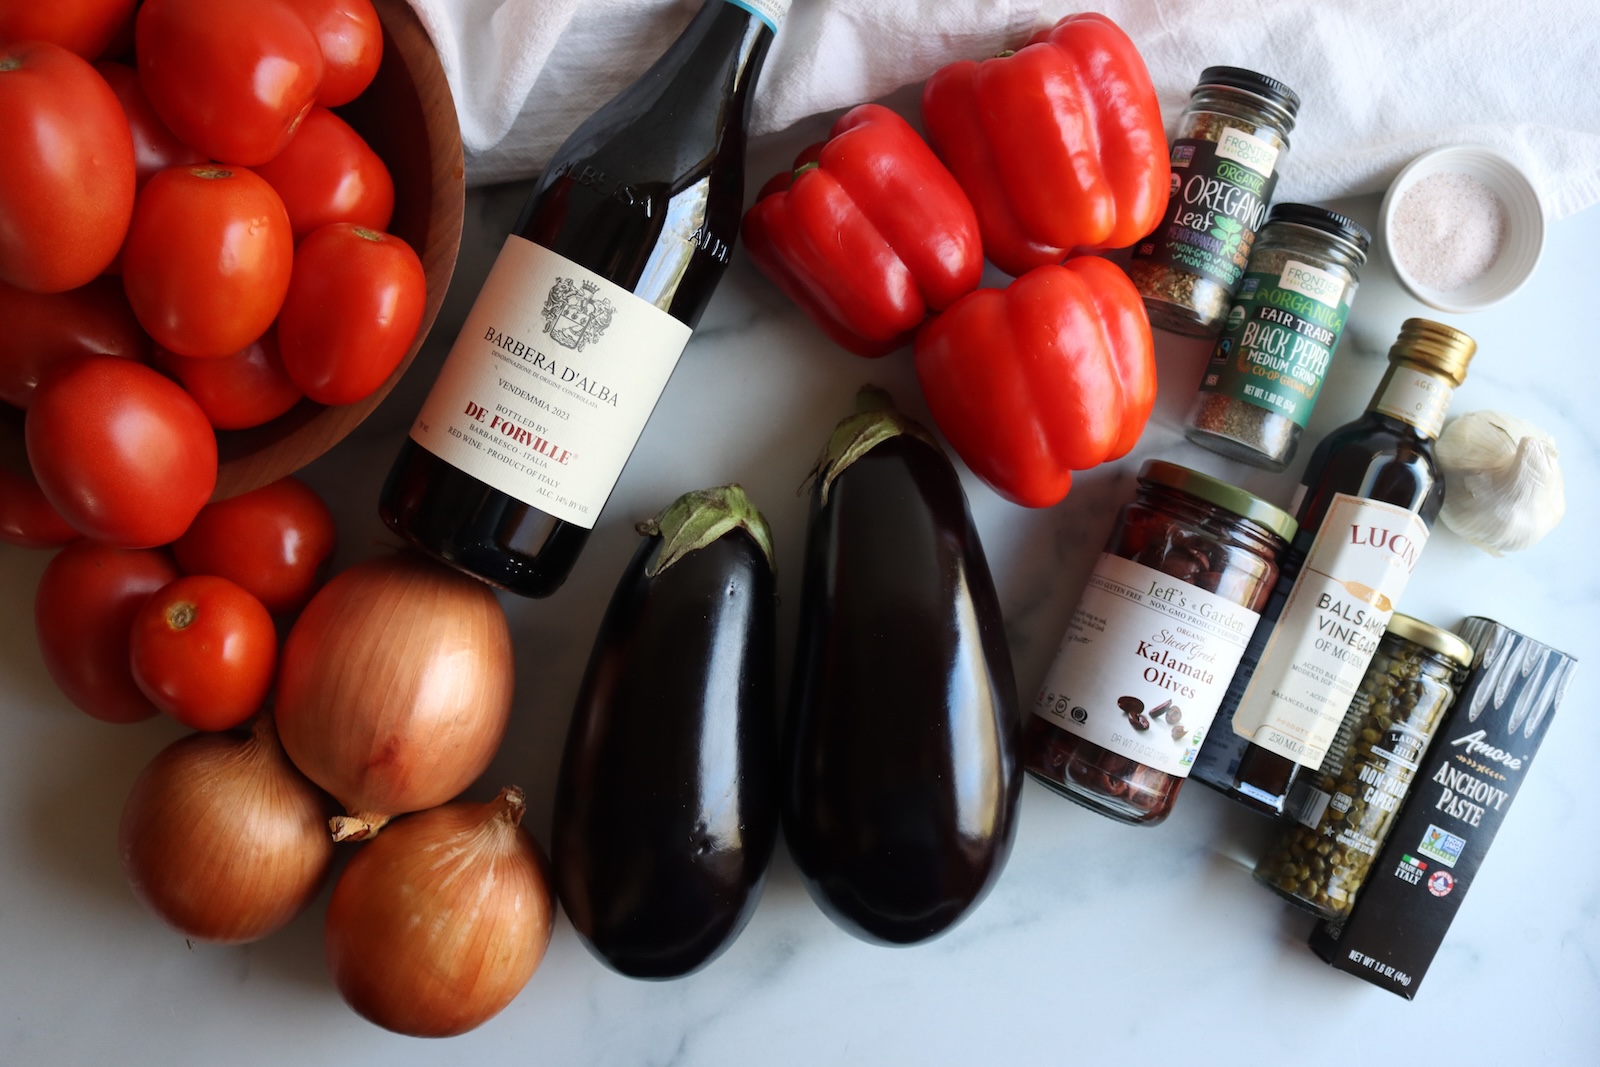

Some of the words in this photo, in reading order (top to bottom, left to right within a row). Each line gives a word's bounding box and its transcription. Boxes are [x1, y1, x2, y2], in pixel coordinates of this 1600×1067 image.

[1224, 135, 1274, 162] FRONTIER
[1216, 163, 1265, 193] ORGANIC
[1173, 203, 1214, 232] Leaf
[1184, 174, 1266, 233] OREGANO
[1167, 225, 1223, 255] MEDITERRANEAN
[1174, 242, 1212, 261] NON-GMO
[1181, 254, 1235, 285] NON-IRRADIATED
[1287, 267, 1340, 295] FRONTIER
[1300, 281, 1326, 296] CO-OP
[1268, 289, 1334, 327] ORGANIC
[1260, 306, 1294, 328] FAIR
[1295, 318, 1335, 346] TRADE
[1240, 321, 1292, 358] BLACK
[1288, 335, 1330, 379] PEPPER
[484, 326, 556, 375] BARBERA
[560, 366, 619, 407] D'ALBA
[491, 350, 532, 374] DENOMINAZIONE
[540, 375, 562, 390] ORIGINE
[561, 386, 599, 409] CONTROLLATA
[1246, 349, 1290, 374] MEDIUM
[1291, 366, 1316, 386] GRIND
[1252, 365, 1280, 381] CO-OP
[1279, 374, 1307, 394] GROWN
[498, 378, 550, 412] VENDEMMIA
[551, 406, 571, 421] 2023
[1243, 384, 1255, 396] NET
[464, 400, 489, 423] DE
[489, 414, 573, 466] FORVILLE
[495, 403, 535, 429] BOTTLED
[535, 424, 549, 435] BY
[447, 426, 462, 439] RED
[462, 434, 483, 450] WINE
[486, 447, 527, 472] PRODUCT
[526, 467, 538, 477] OF
[537, 473, 561, 488] ITALY
[468, 423, 519, 453] BARBARESCO
[522, 452, 548, 469] ITALIA
[555, 494, 568, 505] 14%
[568, 500, 579, 509] BY
[1102, 580, 1126, 595] GLUTEN
[1125, 588, 1143, 602] FREE
[1147, 580, 1187, 608] Jeff's
[1199, 602, 1246, 633] Garden
[1149, 599, 1187, 620] NON-GMO
[1187, 614, 1217, 632] PROJECT
[1151, 628, 1193, 652] Sliced
[1186, 642, 1217, 665] Greek
[1176, 625, 1208, 644] ORGANIC
[1314, 638, 1332, 652] OF
[1319, 615, 1377, 657] VINEGAR
[1135, 639, 1215, 686] Kalamata
[1291, 664, 1319, 681] MODENA
[1320, 677, 1333, 687] IGP
[1302, 661, 1324, 675] ACETO
[1143, 666, 1197, 700] Olives
[1270, 689, 1305, 709] BALANCED
[1304, 705, 1320, 716] AND
[1111, 732, 1122, 744] DR
[1121, 737, 1134, 749] WT
[1268, 732, 1285, 746] 250
[1284, 739, 1298, 753] ML
[1391, 733, 1424, 754] LAUREL
[1392, 744, 1416, 762] HILL
[1451, 729, 1522, 770] Amore
[1335, 793, 1350, 804] NON
[1432, 760, 1510, 812] ANCHOVY
[1435, 787, 1486, 829] PASTE
[1421, 842, 1456, 863] VERIFIED
[1444, 841, 1460, 852] GMO
[1447, 835, 1462, 847] NON
[1394, 868, 1421, 886] ITALY
[1398, 860, 1417, 873] MADE
[1415, 868, 1424, 877] IN
[1348, 949, 1364, 963] NET
[1362, 955, 1376, 969] WT
[1374, 961, 1386, 974] 1.6
[1384, 966, 1396, 979] OZ
[1393, 971, 1412, 987] (44g)
